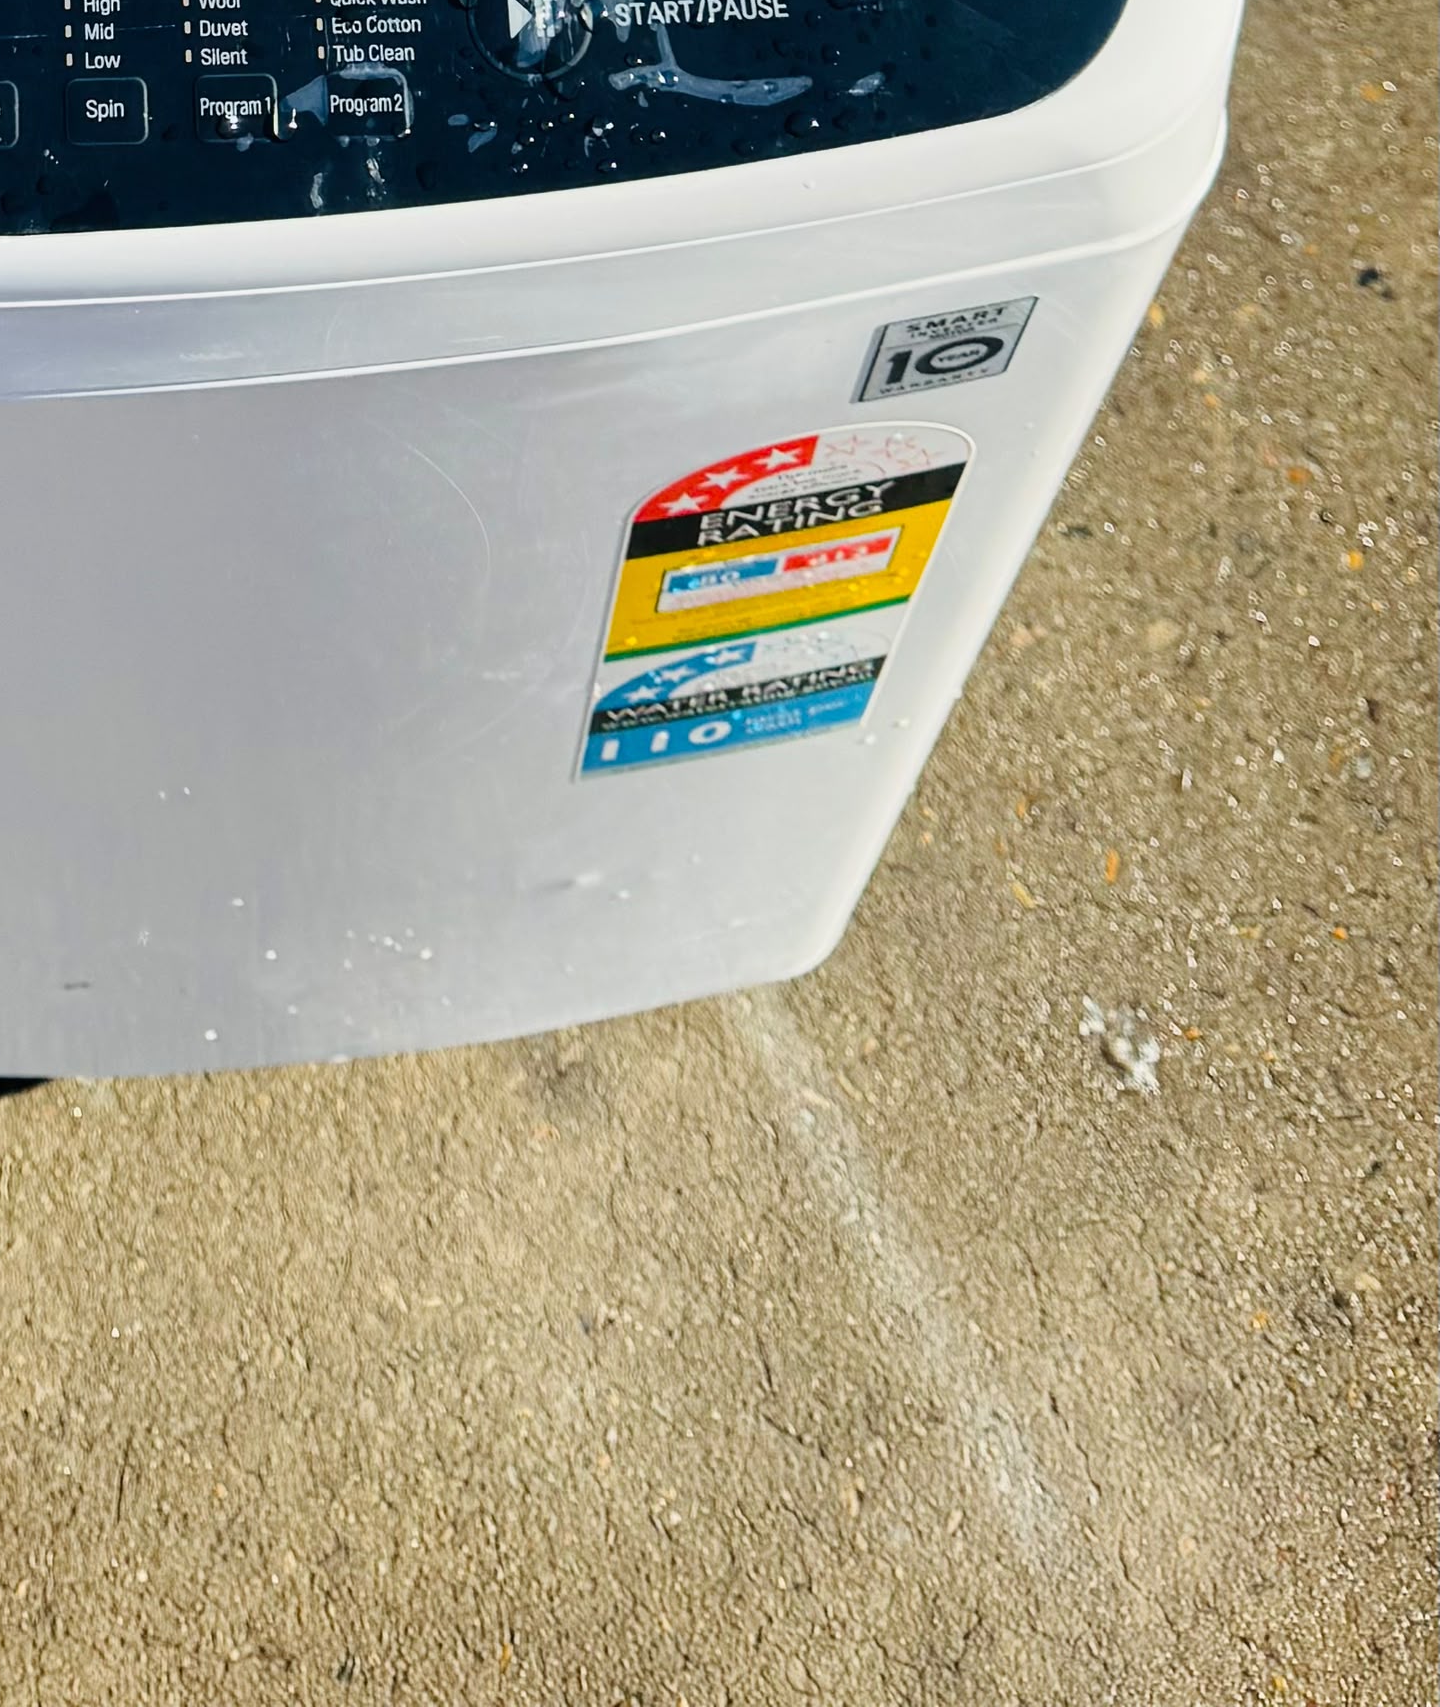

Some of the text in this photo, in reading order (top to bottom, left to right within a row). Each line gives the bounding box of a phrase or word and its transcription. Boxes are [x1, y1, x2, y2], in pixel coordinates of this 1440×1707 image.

[84, 24, 115, 41] Mid
[199, 20, 249, 38] Duvet
[331, 15, 422, 34] Eco Cotton
[85, 52, 121, 70] Low
[200, 48, 249, 66] Silent
[332, 43, 415, 63] Tub Clean
[85, 100, 125, 120] Spin
[199, 96, 272, 120] Program 1
[330, 93, 404, 117] Program 2
[906, 306, 1008, 333] SMART
[885, 336, 1005, 385] 10
[699, 480, 897, 531] ENERGY
[697, 499, 884, 547] RATING
[606, 691, 729, 721] WATER
